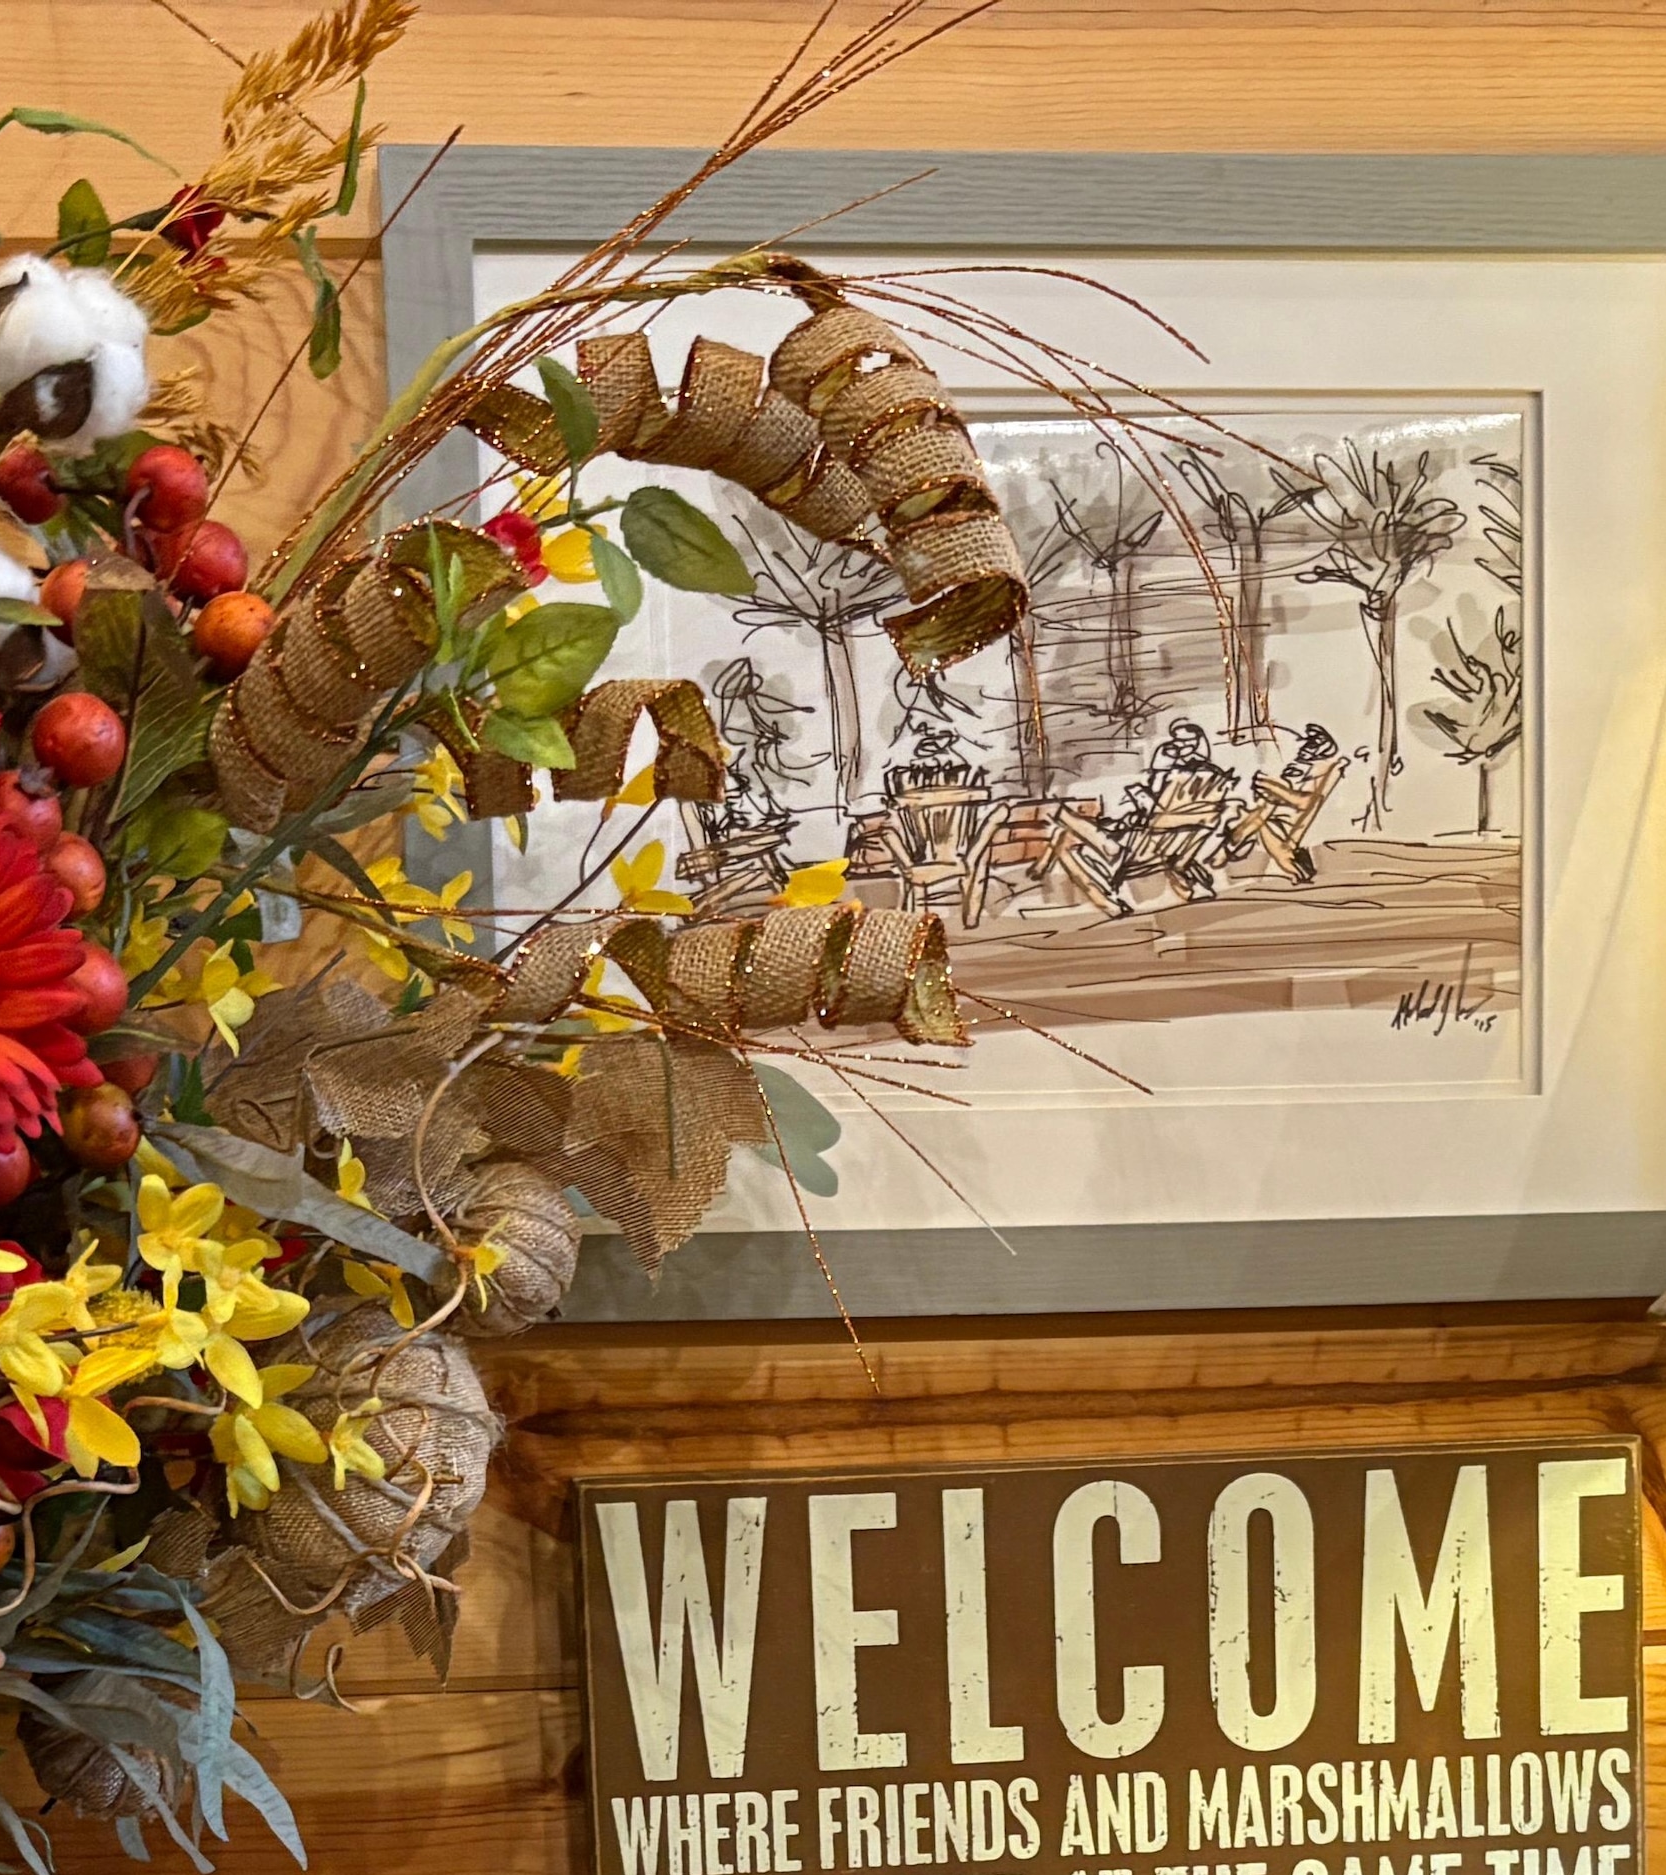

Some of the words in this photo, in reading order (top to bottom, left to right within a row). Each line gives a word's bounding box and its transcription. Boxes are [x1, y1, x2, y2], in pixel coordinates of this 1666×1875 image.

[595, 1458, 1630, 1781] WELCOME
[818, 1777, 1040, 1869] FRIENDS
[1060, 1771, 1168, 1856] AND
[1188, 1747, 1631, 1851] MARSHMALLOWS
